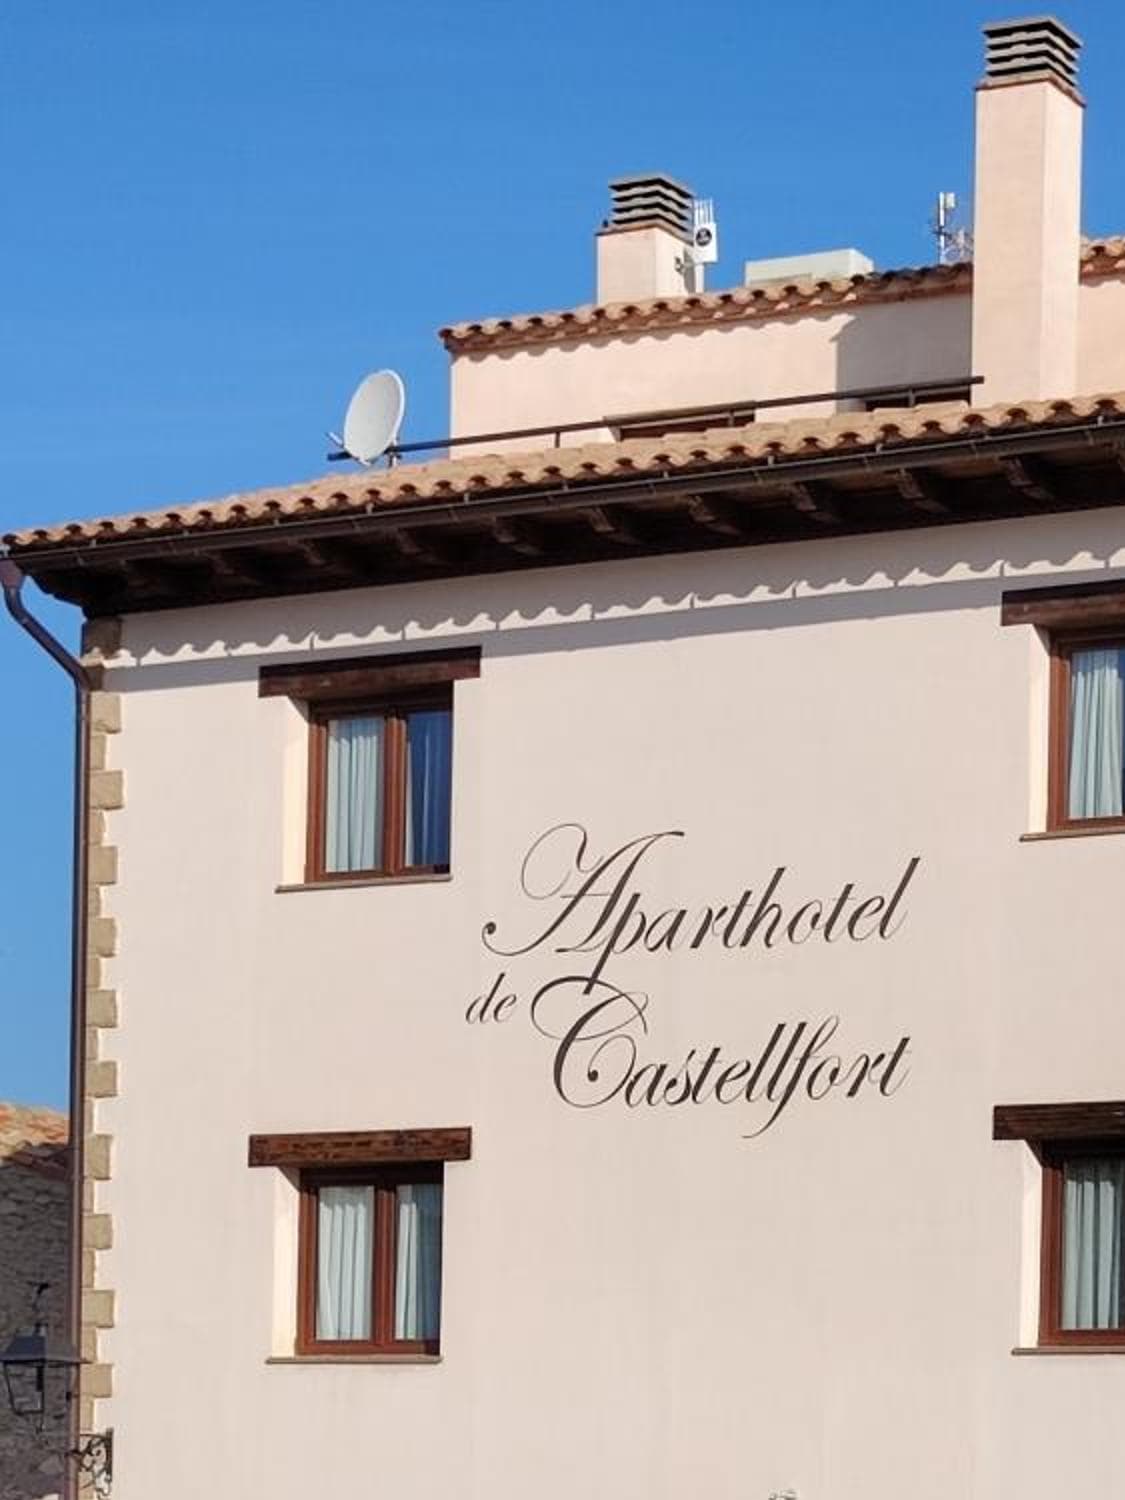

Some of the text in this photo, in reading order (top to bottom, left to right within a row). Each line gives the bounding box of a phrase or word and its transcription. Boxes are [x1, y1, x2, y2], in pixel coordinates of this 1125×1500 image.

[481, 822, 921, 995] Aparthotel
[465, 972, 912, 1139] de Castellfort
